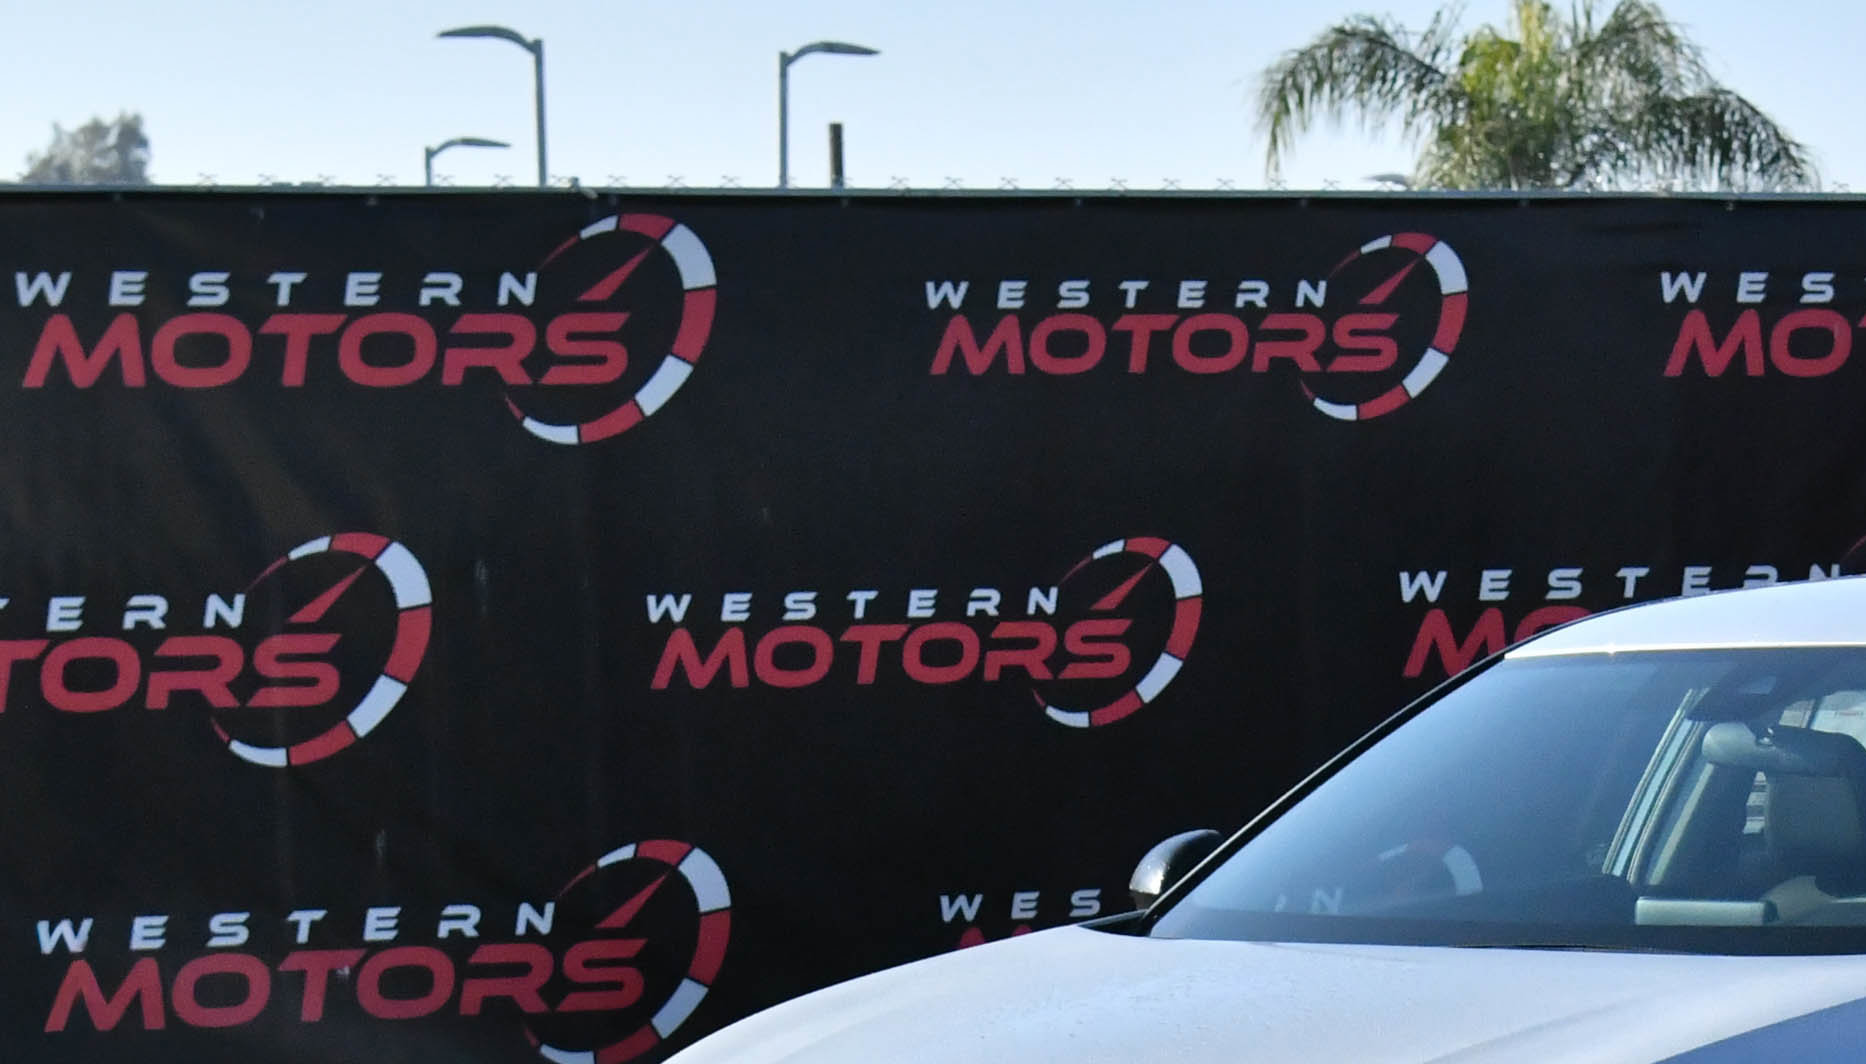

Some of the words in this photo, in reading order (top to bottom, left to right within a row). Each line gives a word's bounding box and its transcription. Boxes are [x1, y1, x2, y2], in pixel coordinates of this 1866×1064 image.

[14, 272, 538, 307] WESTERN
[925, 280, 1327, 310] WESTERN
[22, 311, 630, 388] MOTORS
[929, 312, 1400, 376] MOTORS
[0, 593, 246, 632] ERN
[646, 586, 1058, 623] WESTERN
[650, 619, 1133, 690] MOTORS
[36, 902, 556, 954] WESTERN
[44, 938, 649, 1033] MOTORS
